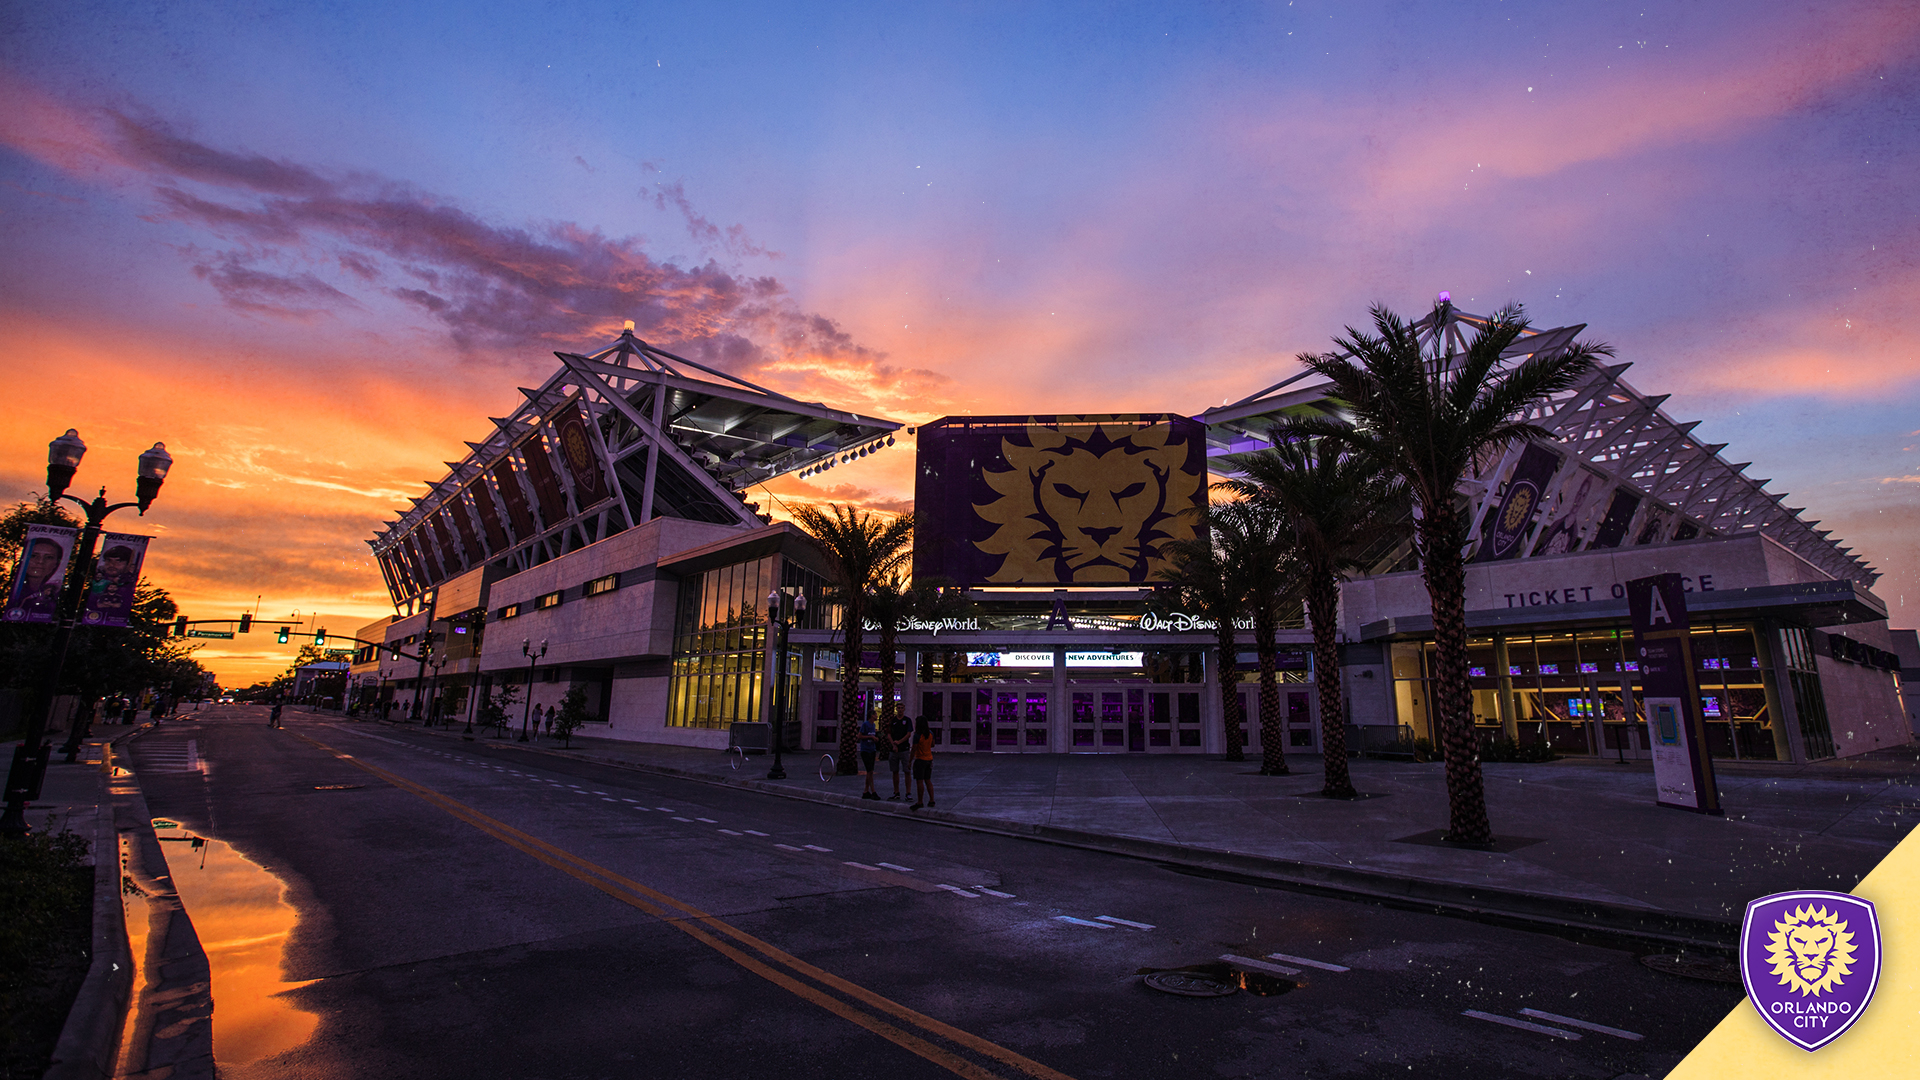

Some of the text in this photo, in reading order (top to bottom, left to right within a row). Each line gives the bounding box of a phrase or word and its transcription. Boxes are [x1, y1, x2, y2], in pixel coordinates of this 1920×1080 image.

[30, 526, 48, 534] OUR
[1496, 531, 1515, 542] ORLANDO
[1504, 575, 1715, 608] TICKET OCE
[1046, 598, 1074, 631] A
[1649, 585, 1672, 626] A
[1139, 611, 1174, 632] Walt
